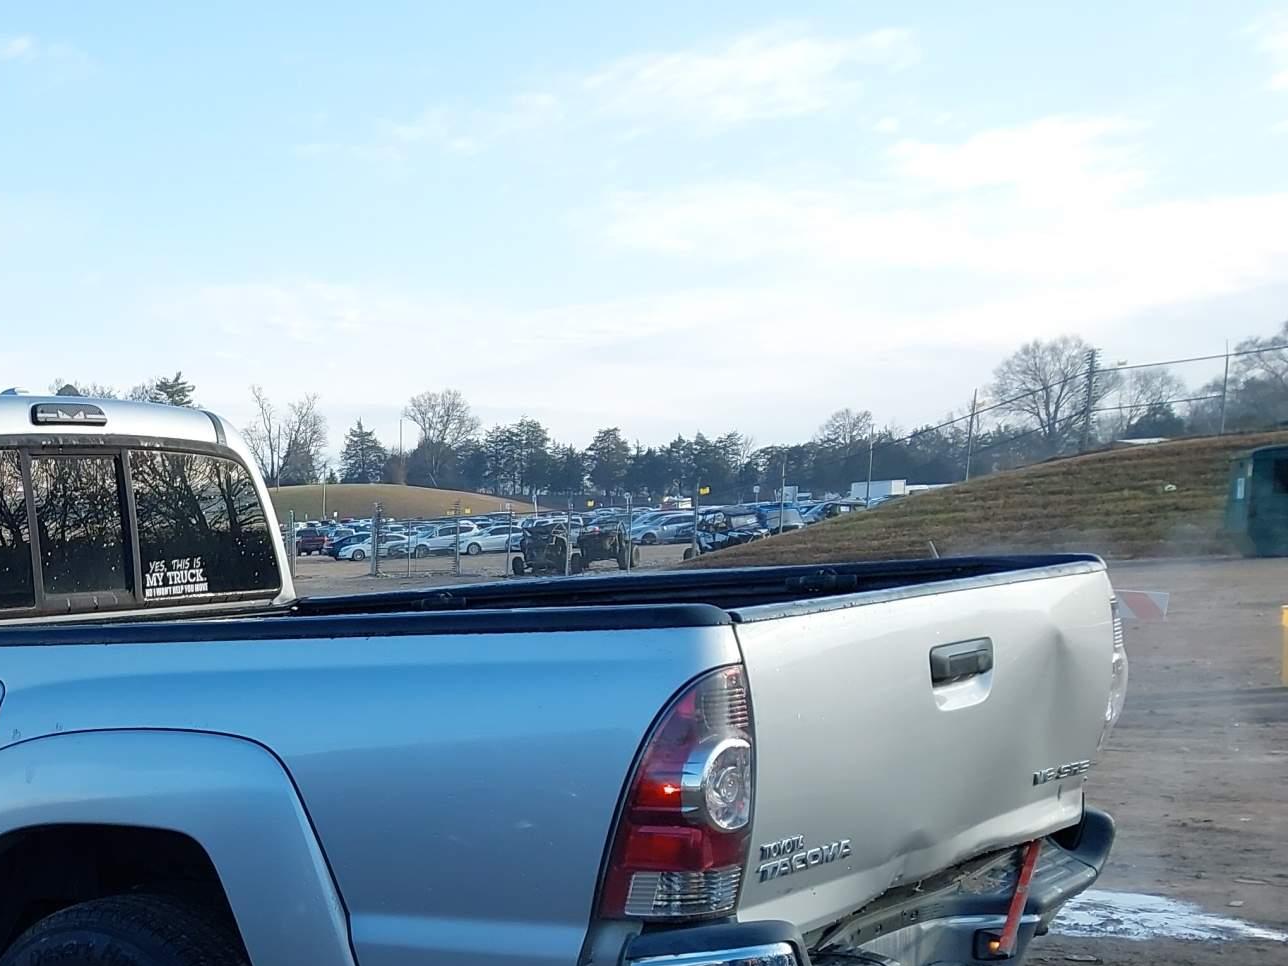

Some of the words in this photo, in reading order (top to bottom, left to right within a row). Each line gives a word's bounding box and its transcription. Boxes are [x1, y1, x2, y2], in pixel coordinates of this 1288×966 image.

[149, 560, 167, 573] YES,
[172, 557, 190, 570] THIS
[194, 556, 201, 569] IS
[145, 572, 164, 587] MY
[167, 568, 207, 585] TRUCK.
[760, 835, 804, 861] TOYOTA
[758, 840, 851, 882] TACOMA
